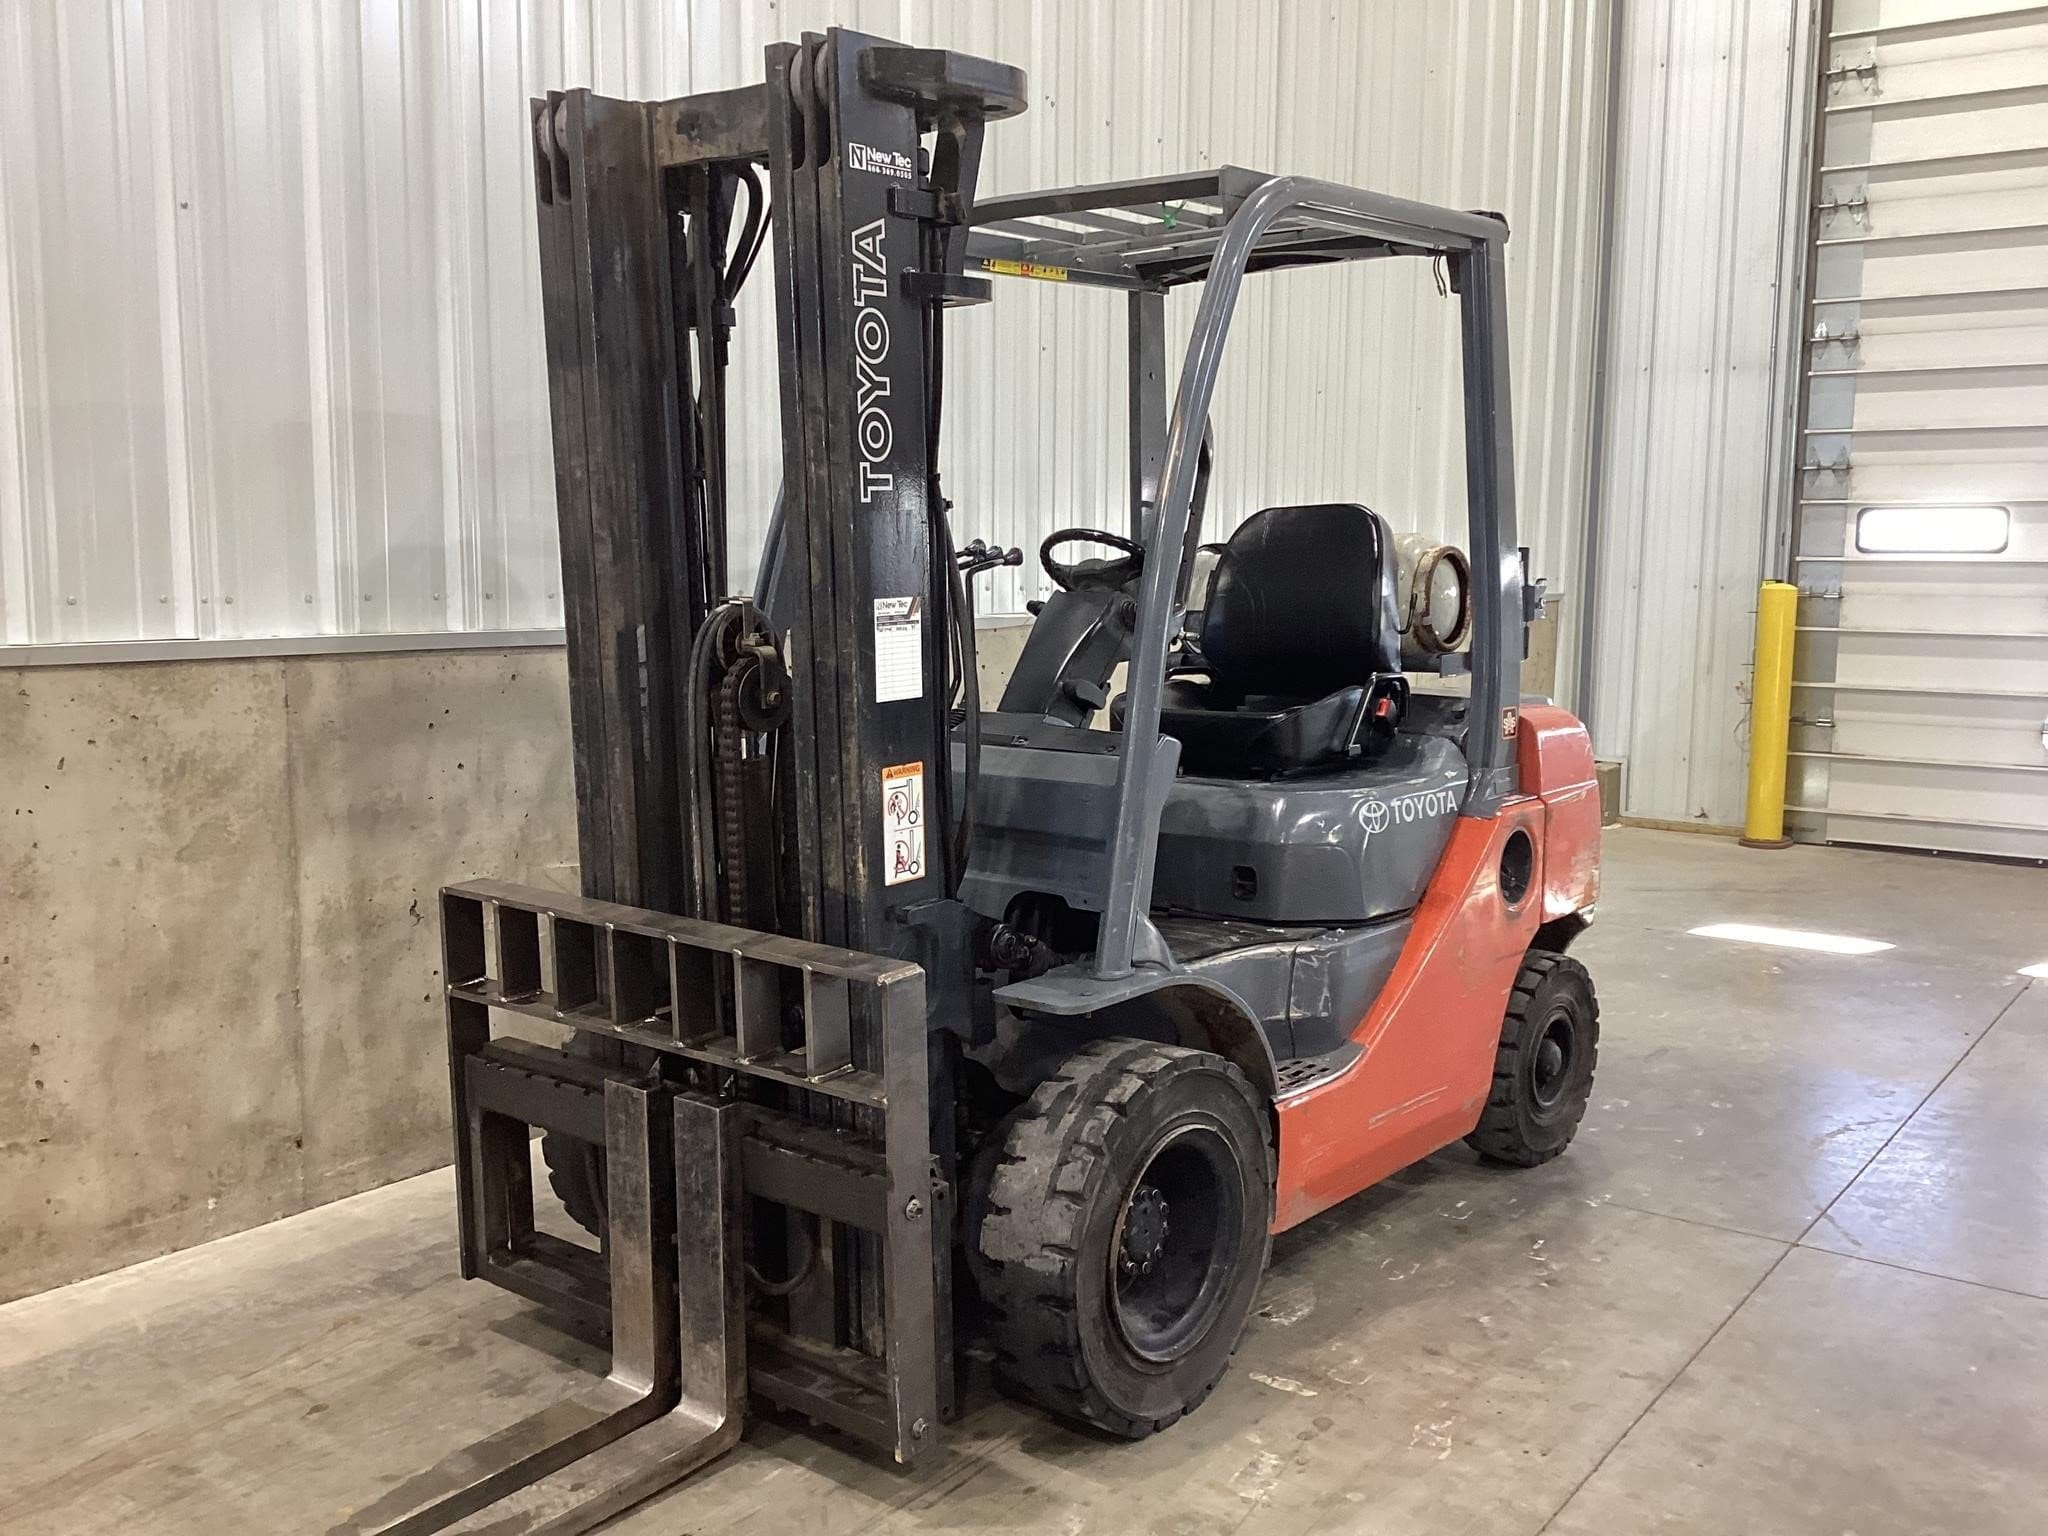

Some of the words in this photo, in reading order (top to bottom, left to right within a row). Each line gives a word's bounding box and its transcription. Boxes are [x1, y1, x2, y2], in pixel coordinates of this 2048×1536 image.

[867, 146, 892, 164] New
[892, 151, 912, 168] Tec
[851, 218, 894, 504] TOYOTA
[1390, 790, 1458, 824] TOYOTA
